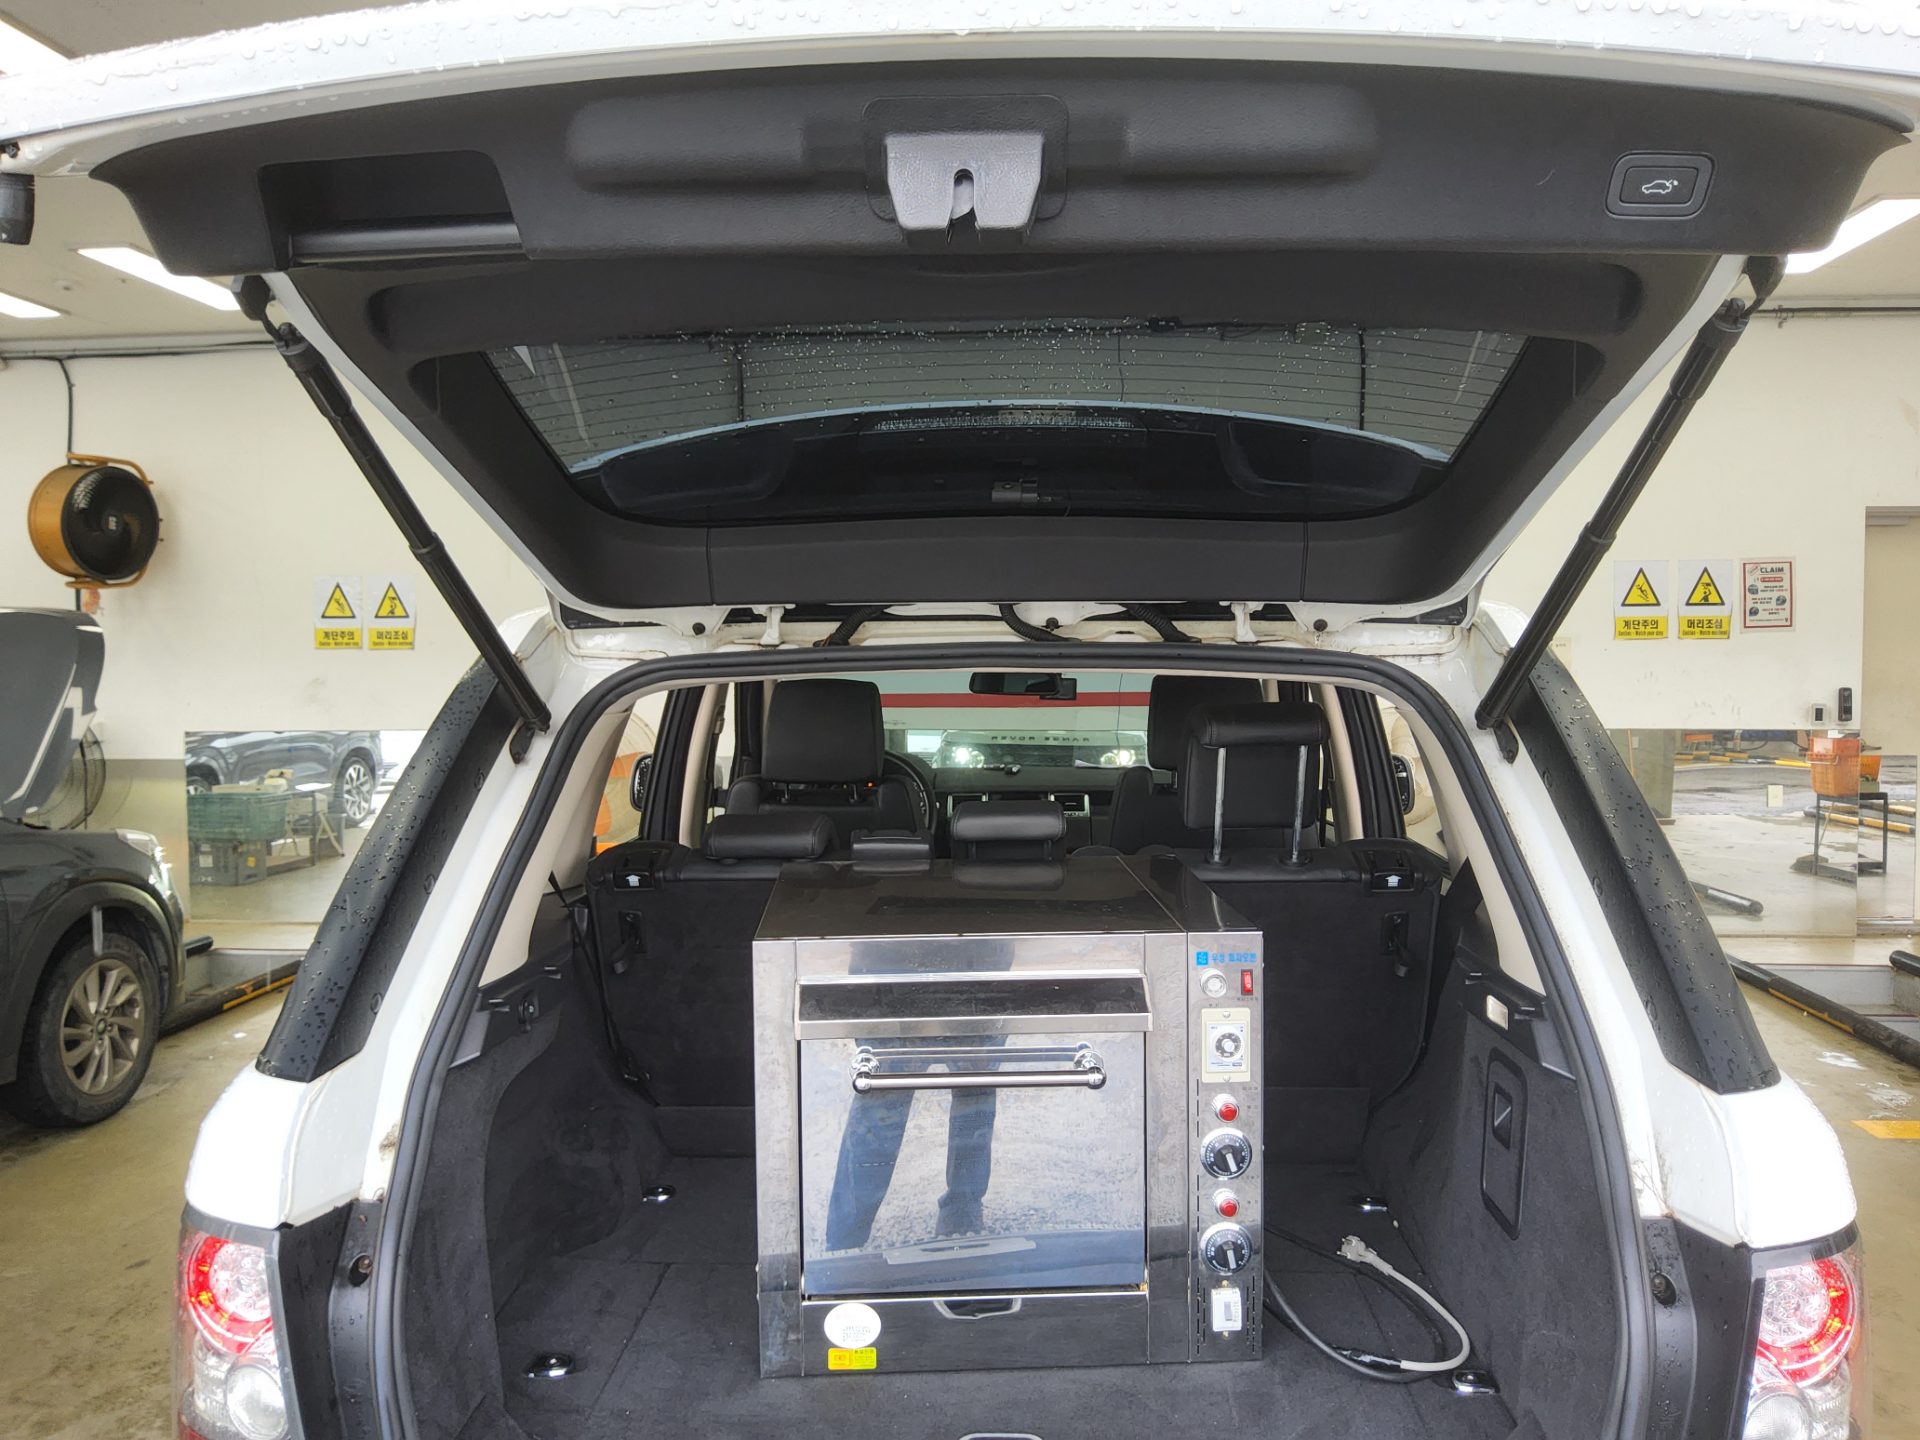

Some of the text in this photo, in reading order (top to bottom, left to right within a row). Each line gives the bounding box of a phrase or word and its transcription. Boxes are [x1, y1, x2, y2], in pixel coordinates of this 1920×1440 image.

[1622, 619, 1659, 630] 계단주의
[1686, 618, 1723, 630] 머리조심
[323, 631, 355, 640] 계단주의
[376, 631, 408, 640] 머리조심
